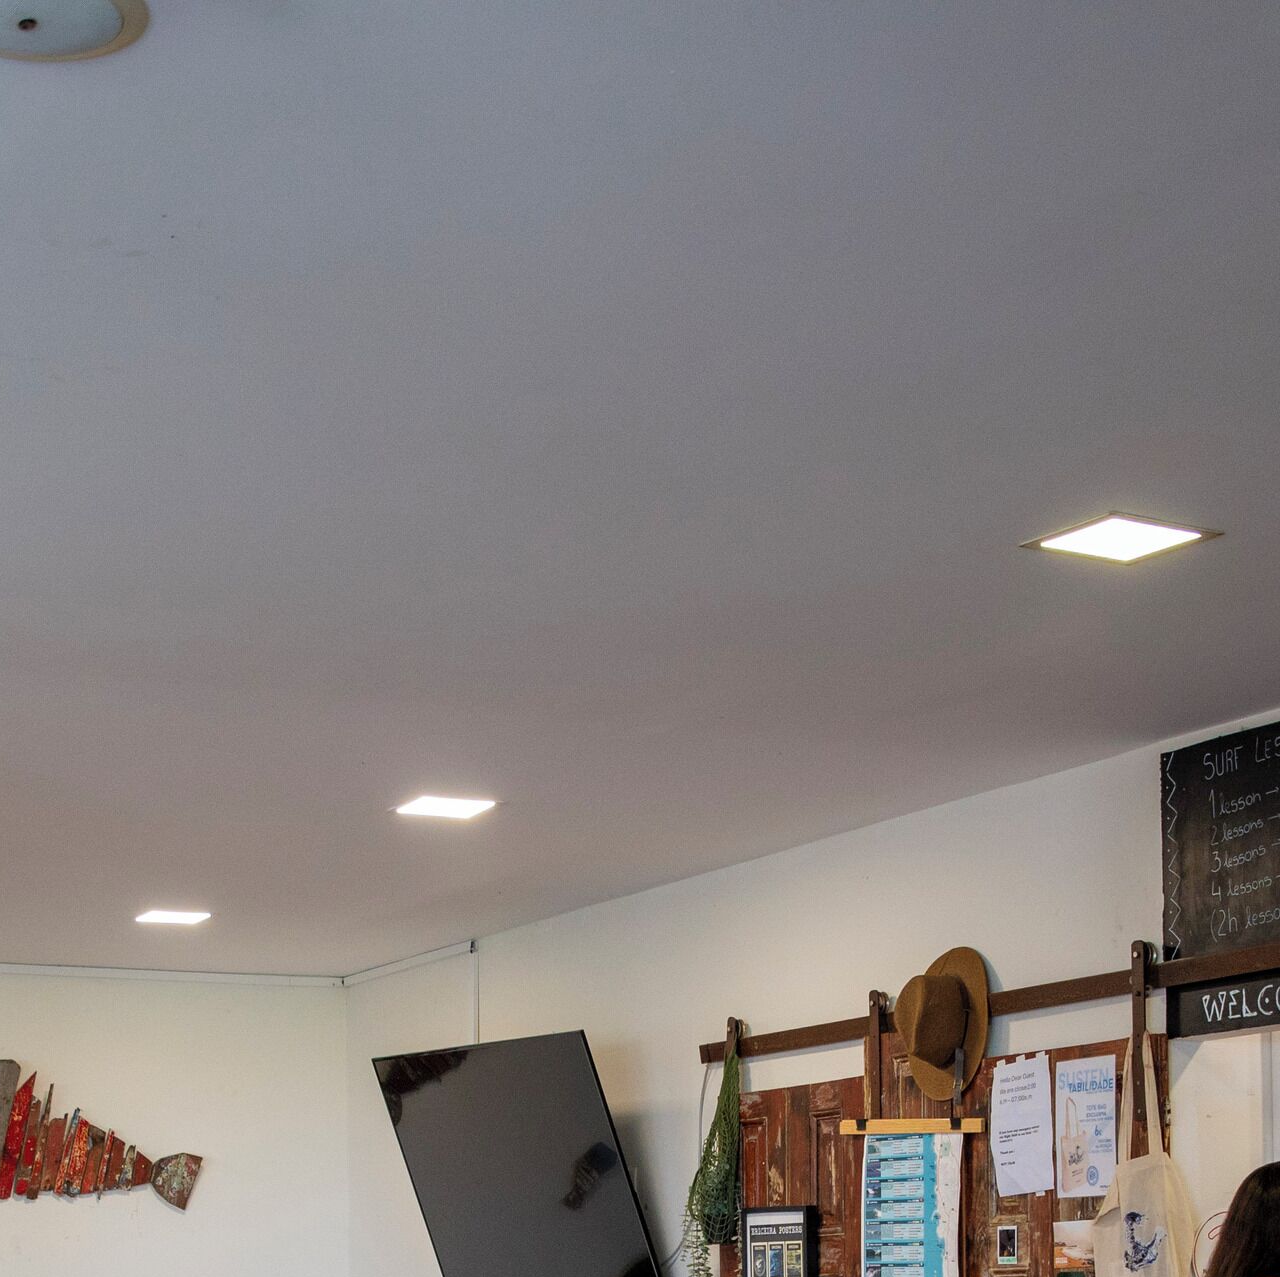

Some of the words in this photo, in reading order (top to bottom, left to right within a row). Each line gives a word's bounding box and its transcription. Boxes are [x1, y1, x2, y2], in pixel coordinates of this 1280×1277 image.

[1203, 746, 1244, 781] SURF
[1209, 789, 1216, 819] 1
[1219, 791, 1262, 816] lesson
[1210, 825, 1219, 846] 2
[1221, 818, 1265, 843] lessons
[1211, 851, 1221, 873] 3
[1222, 845, 1266, 869] lessons
[1211, 880, 1222, 902] 4
[1227, 875, 1273, 897] lessons
[1067, 1078, 1114, 1094] TABILIDADE
[778, 1225, 803, 1234] POSTERS
